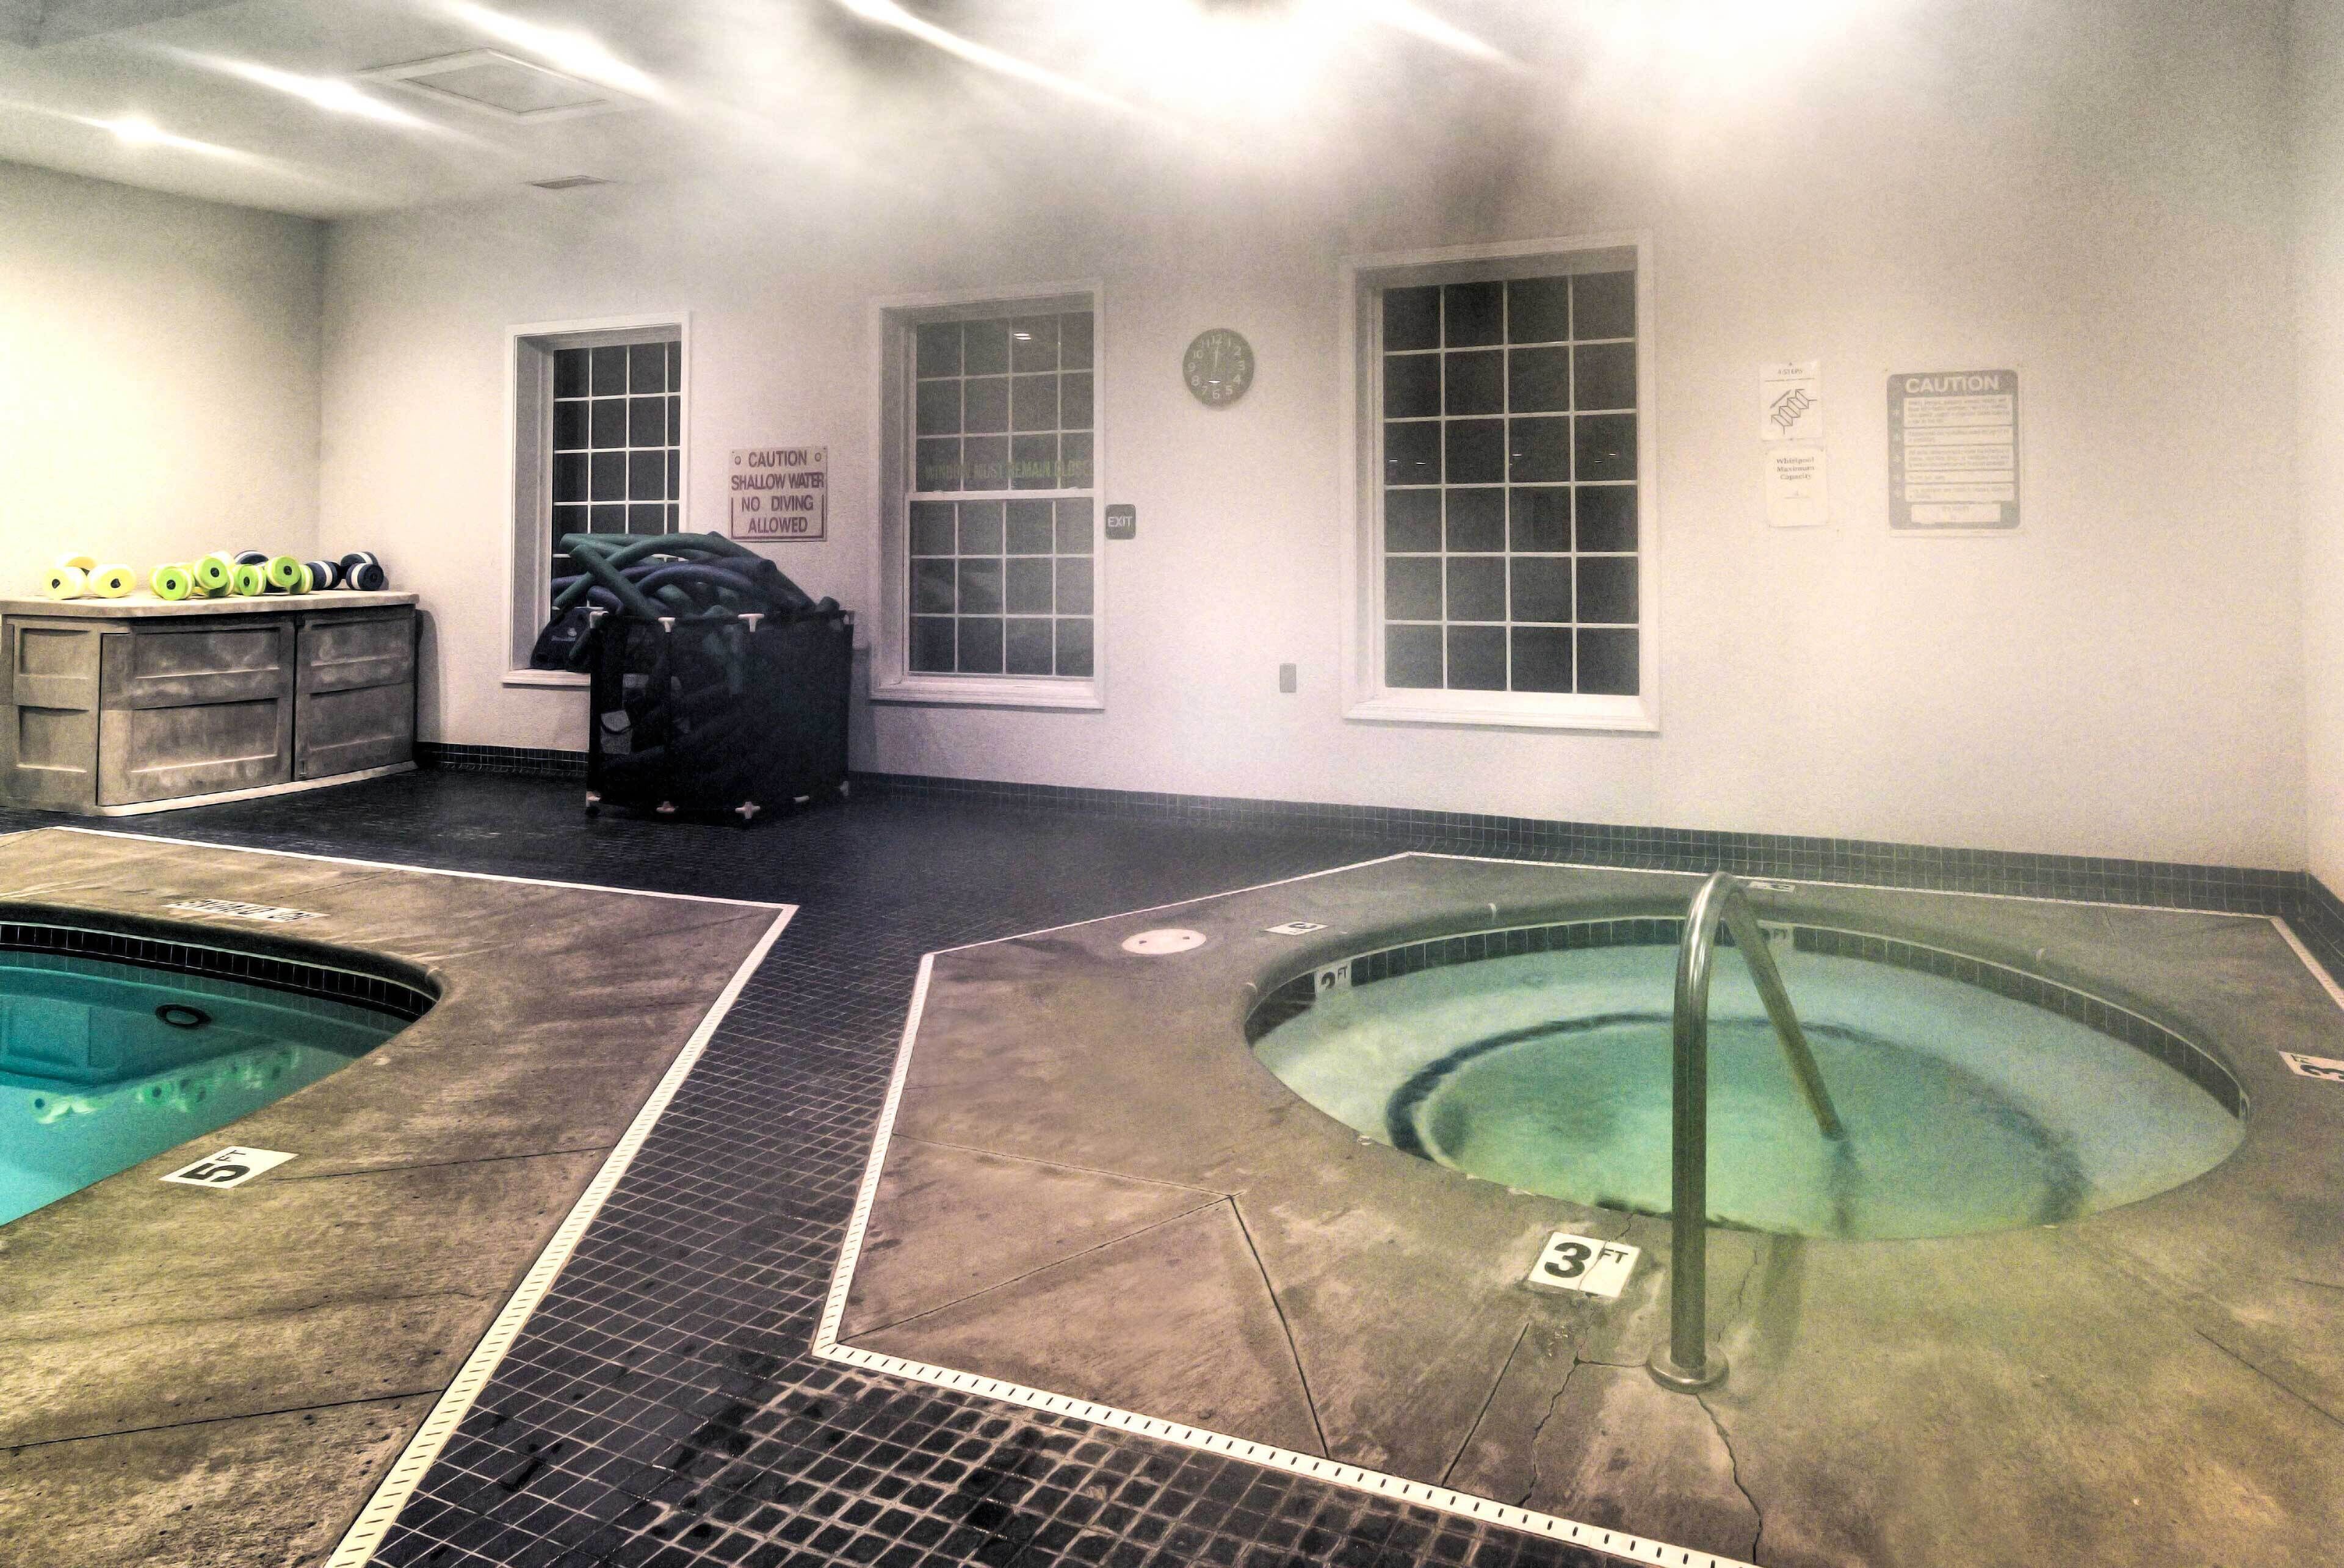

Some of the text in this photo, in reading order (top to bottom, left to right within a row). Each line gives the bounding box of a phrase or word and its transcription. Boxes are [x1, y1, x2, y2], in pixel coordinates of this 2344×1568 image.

[1193, 349, 1203, 359] 10
[1234, 345, 1242, 356] 2
[1188, 362, 1196, 372] 9
[1191, 375, 1200, 386] 8
[1233, 374, 1242, 385] 4
[1905, 374, 2000, 394] CAUTION
[1212, 389, 1220, 399] 6
[1226, 385, 1233, 395] 5
[748, 450, 807, 468] CAUTION
[731, 472, 824, 491] SHALLOW WATER
[741, 494, 814, 512] NO DIVING
[748, 516, 808, 534] ALLOWED
[1107, 516, 1133, 528] EXIT
[1337, 966, 1348, 980] FT
[178, 1149, 250, 1182] 5 FT
[1544, 1242, 1629, 1278] 3 FT
